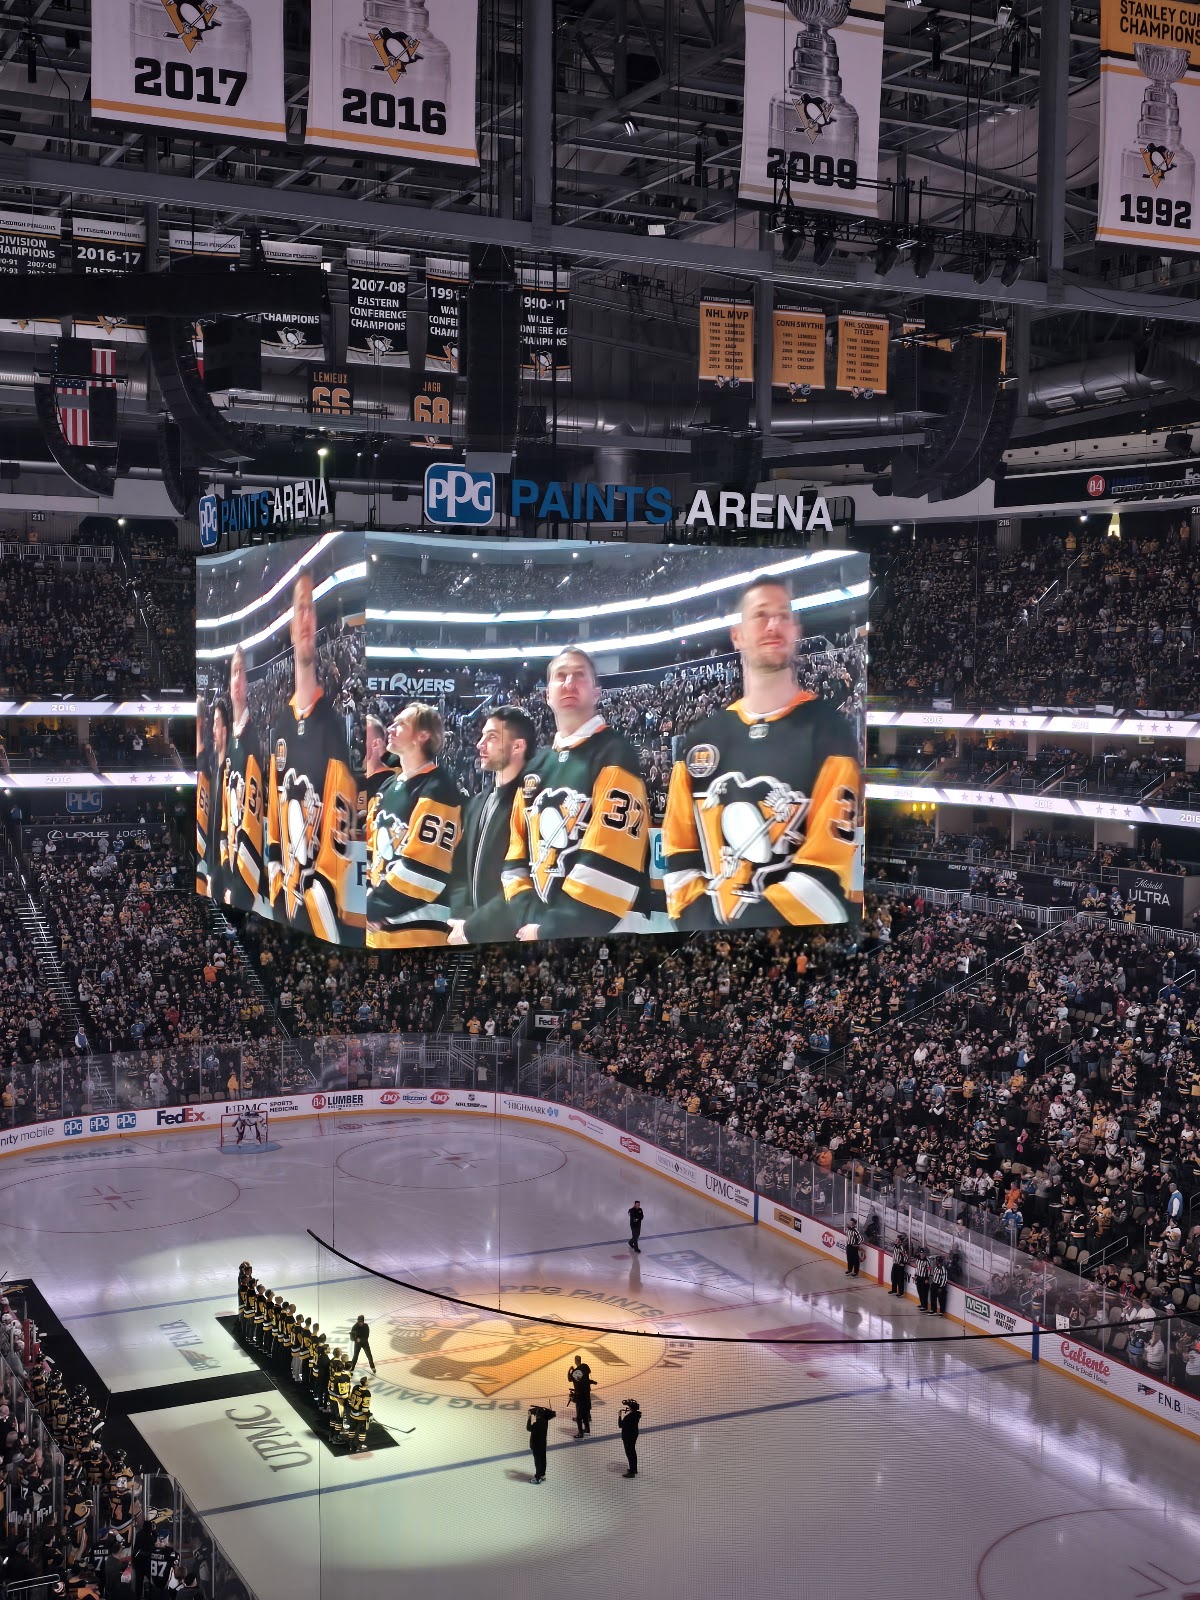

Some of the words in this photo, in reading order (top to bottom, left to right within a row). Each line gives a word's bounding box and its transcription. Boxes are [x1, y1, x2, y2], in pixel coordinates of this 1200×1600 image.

[1120, 0, 1176, 23] STANLEY
[1120, 16, 1200, 46] CHAMPIONS
[134, 57, 248, 107] 2017
[342, 88, 447, 136] 2016
[767, 147, 858, 190] 2009
[1120, 193, 1192, 230] 1992
[0, 245, 56, 258] HAMPIONS
[77, 247, 141, 264] 2016-17
[351, 278, 406, 293] 2007-08
[357, 296, 399, 308] EASTERN
[263, 313, 320, 324] CHAMPIONS
[350, 307, 407, 319] CONFERENCE
[705, 309, 725, 319] NHL
[727, 311, 749, 320] MVP
[351, 319, 406, 331] CHAMPIONS
[796, 321, 824, 330] SMYTHE
[858, 323, 884, 331] SCORING
[313, 372, 347, 384] LEMIEUX
[414, 395, 450, 424] 68
[1089, 479, 1103, 492] 84
[428, 470, 491, 517] PPG
[511, 479, 673, 525] PAINTS
[685, 489, 834, 531] ARENA
[200, 502, 218, 541] PPG
[221, 490, 269, 533] PAINTS
[272, 477, 329, 524] ARENA
[366, 672, 455, 694] ETRIVERS
[51, 704, 76, 712] 2016
[922, 715, 943, 724] 2016
[45, 776, 71, 784] 2016
[68, 792, 100, 810] PPG
[65, 830, 110, 838] LEXUS
[418, 813, 456, 851] 62
[1129, 888, 1171, 907] ULTRA
[313, 1096, 325, 1107] 84
[327, 1095, 364, 1106] LUMBER
[508, 1101, 546, 1116] HIGHMARK
[91, 1117, 109, 1132] PPG
[118, 1114, 136, 1128] PPG
[157, 1107, 206, 1126] FedEx
[20, 1126, 55, 1142] mobile
[65, 1121, 82, 1135] PPG
[704, 1174, 734, 1200] UPMC
[500, 1285, 562, 1296] PPG
[568, 1288, 666, 1318] PAINTS
[966, 1297, 990, 1317] MSA
[1060, 1341, 1111, 1377] Caliente
[446, 1397, 522, 1411] PPG
[1158, 1391, 1183, 1414] F.N.B.
[225, 1404, 312, 1473] UPMC
[151, 1560, 168, 1578] 87
